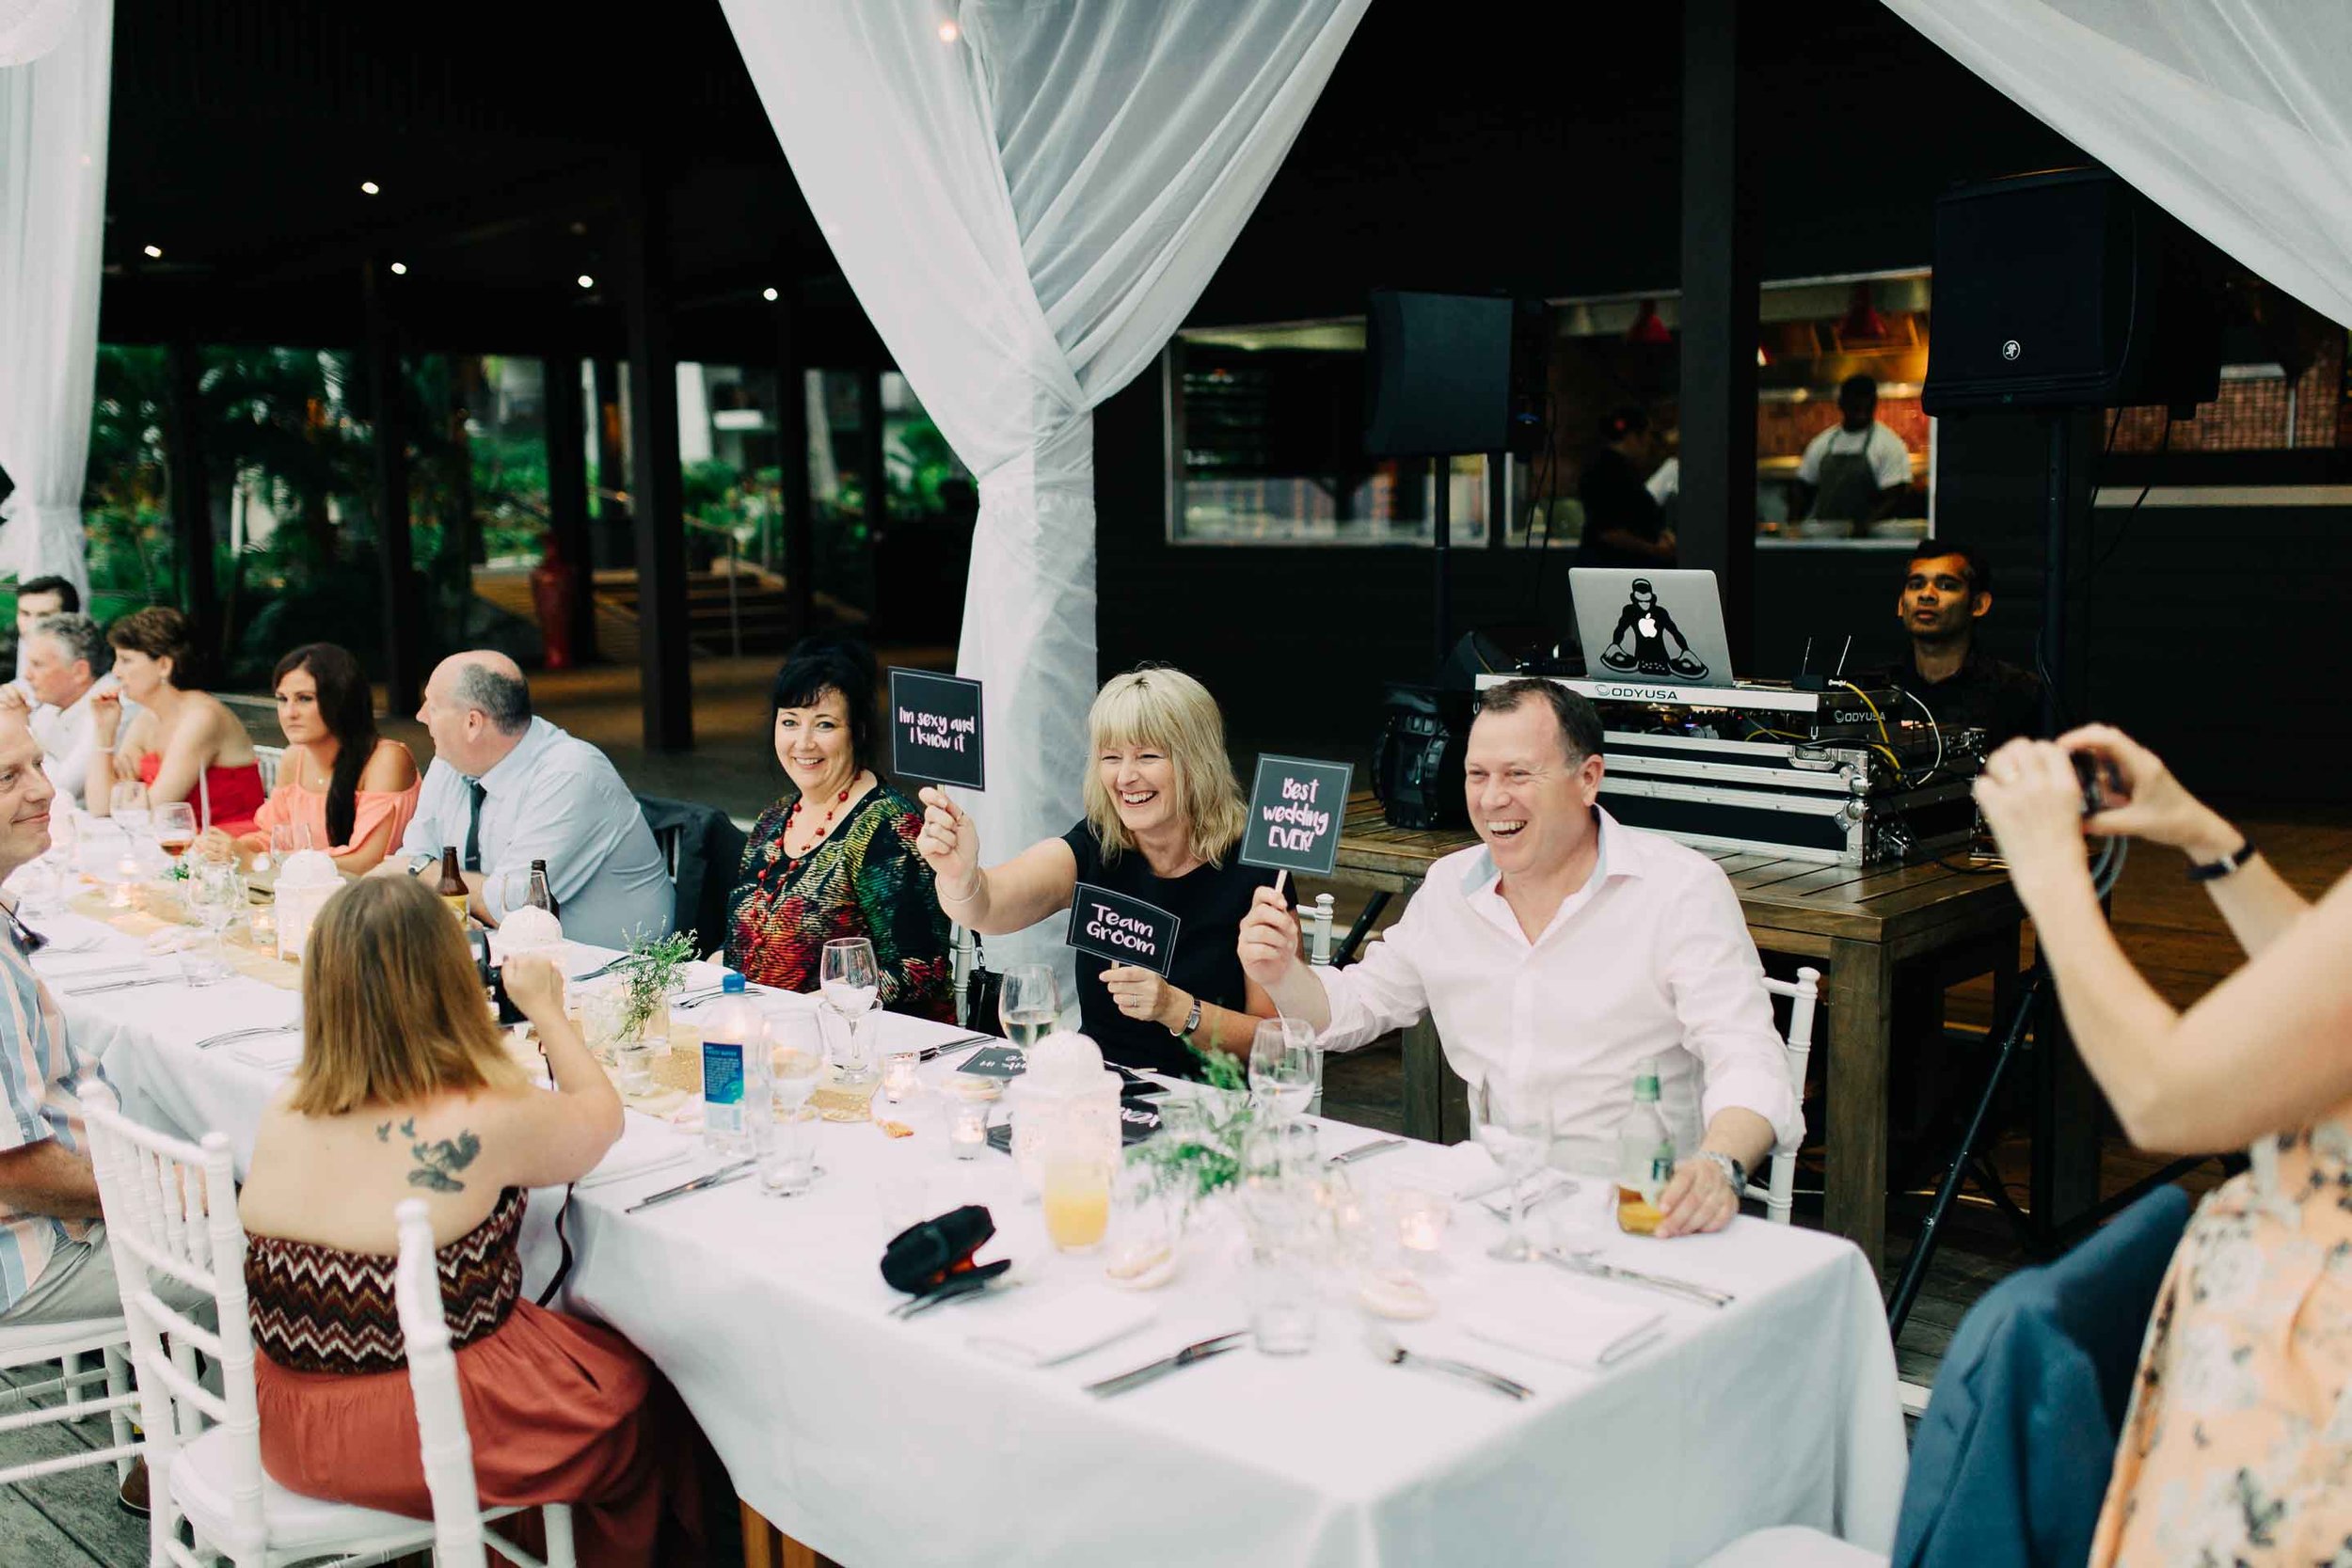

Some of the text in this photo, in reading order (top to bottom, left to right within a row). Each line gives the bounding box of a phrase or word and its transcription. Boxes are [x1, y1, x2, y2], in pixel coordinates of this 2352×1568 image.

[910, 726, 964, 752] I know it
[917, 712, 948, 735] sexy
[950, 716, 975, 735] and
[1281, 777, 1320, 804] Best
[1263, 801, 1329, 836] wedding
[1091, 902, 1154, 938] Team
[1086, 920, 1156, 956] Groom
